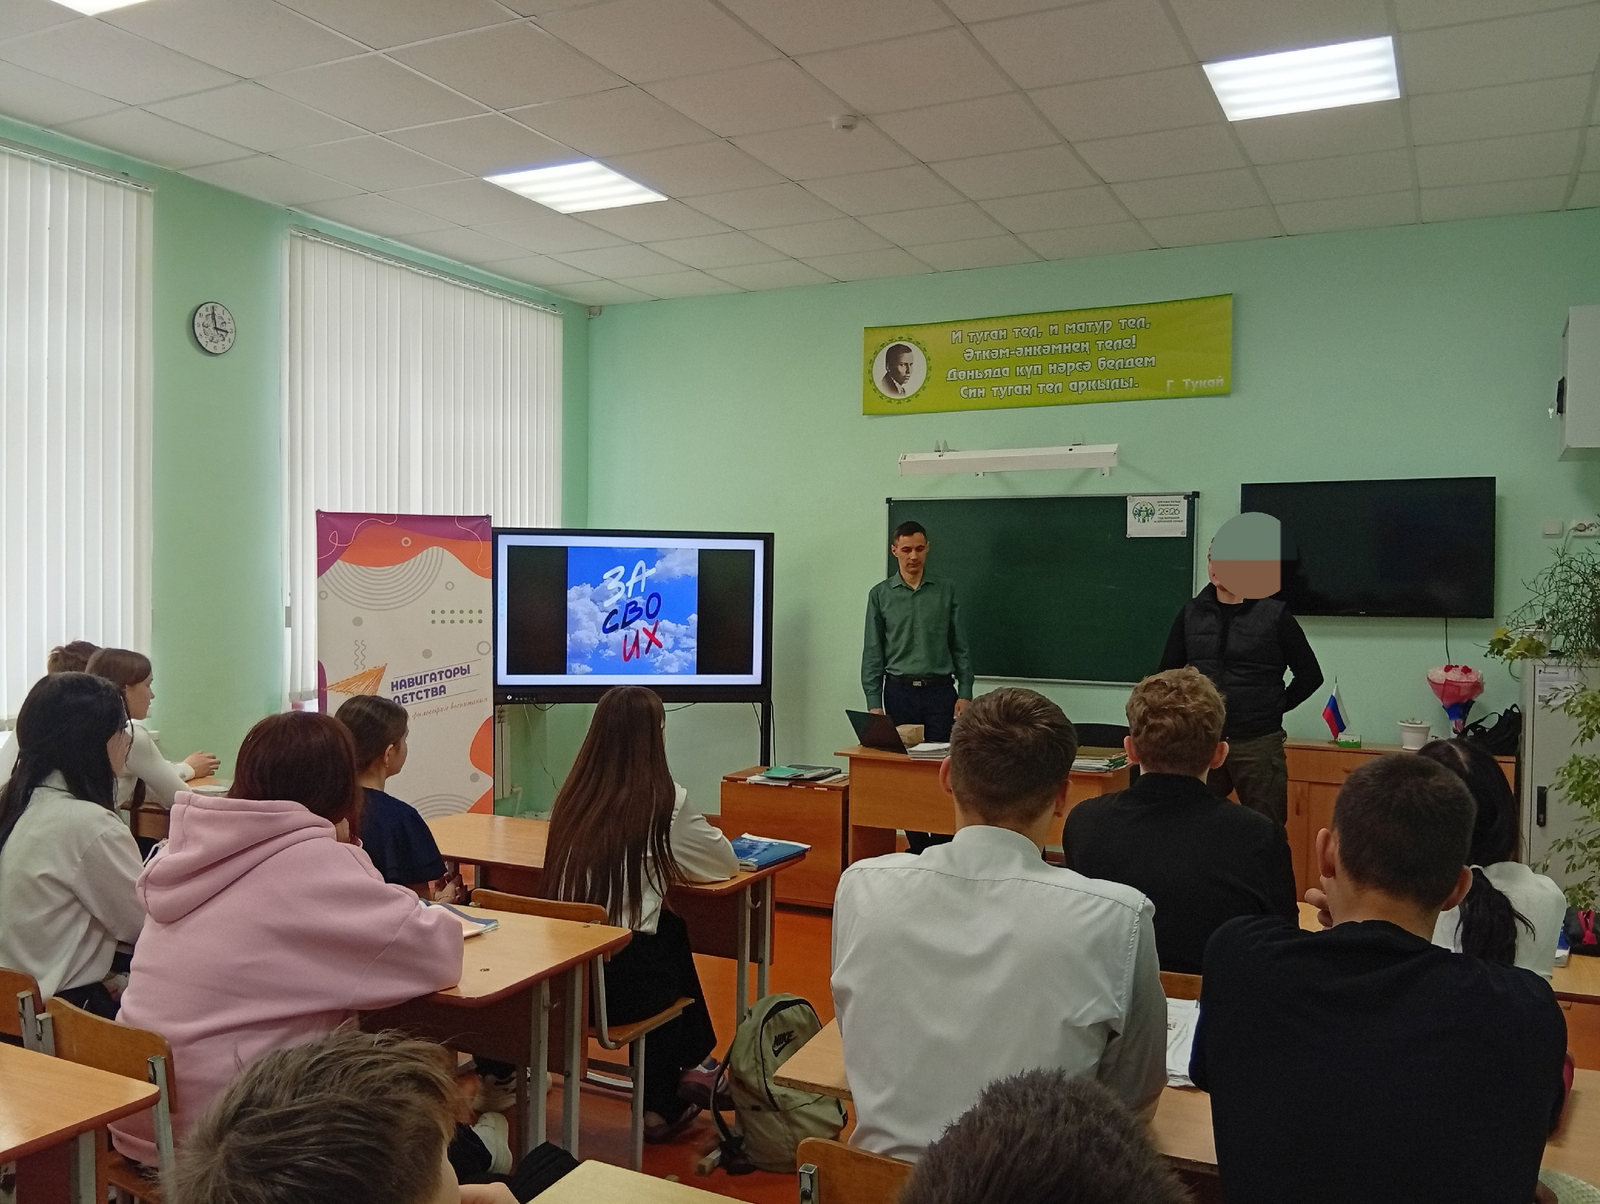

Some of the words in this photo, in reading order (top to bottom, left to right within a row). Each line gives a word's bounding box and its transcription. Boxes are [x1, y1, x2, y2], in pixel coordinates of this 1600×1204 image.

[951, 330, 963, 344] И
[967, 328, 1007, 345] туган
[1012, 326, 1043, 339] тел,
[1049, 323, 1059, 336] и
[1064, 319, 1113, 335] матур
[1118, 316, 1151, 330] тел,
[963, 341, 1090, 362] Әткәм-әнкәмнең
[1096, 334, 1137, 352] теле!
[946, 366, 1010, 382] Дөньяда
[1015, 364, 1042, 379] күп
[1048, 360, 1092, 377] нәрсә
[1097, 355, 1156, 371] белдем
[960, 385, 986, 399] Син
[991, 383, 1032, 400] туган
[1037, 381, 1063, 394] тел
[1068, 377, 1139, 395] аркылы.
[1182, 375, 1224, 392] Тукай
[1158, 507, 1180, 515] 2026
[602, 559, 657, 608] ЗА
[602, 592, 662, 635] СВО
[390, 664, 471, 692] НАВИГАТОРЫ
[773, 1029, 795, 1048] NIKE
